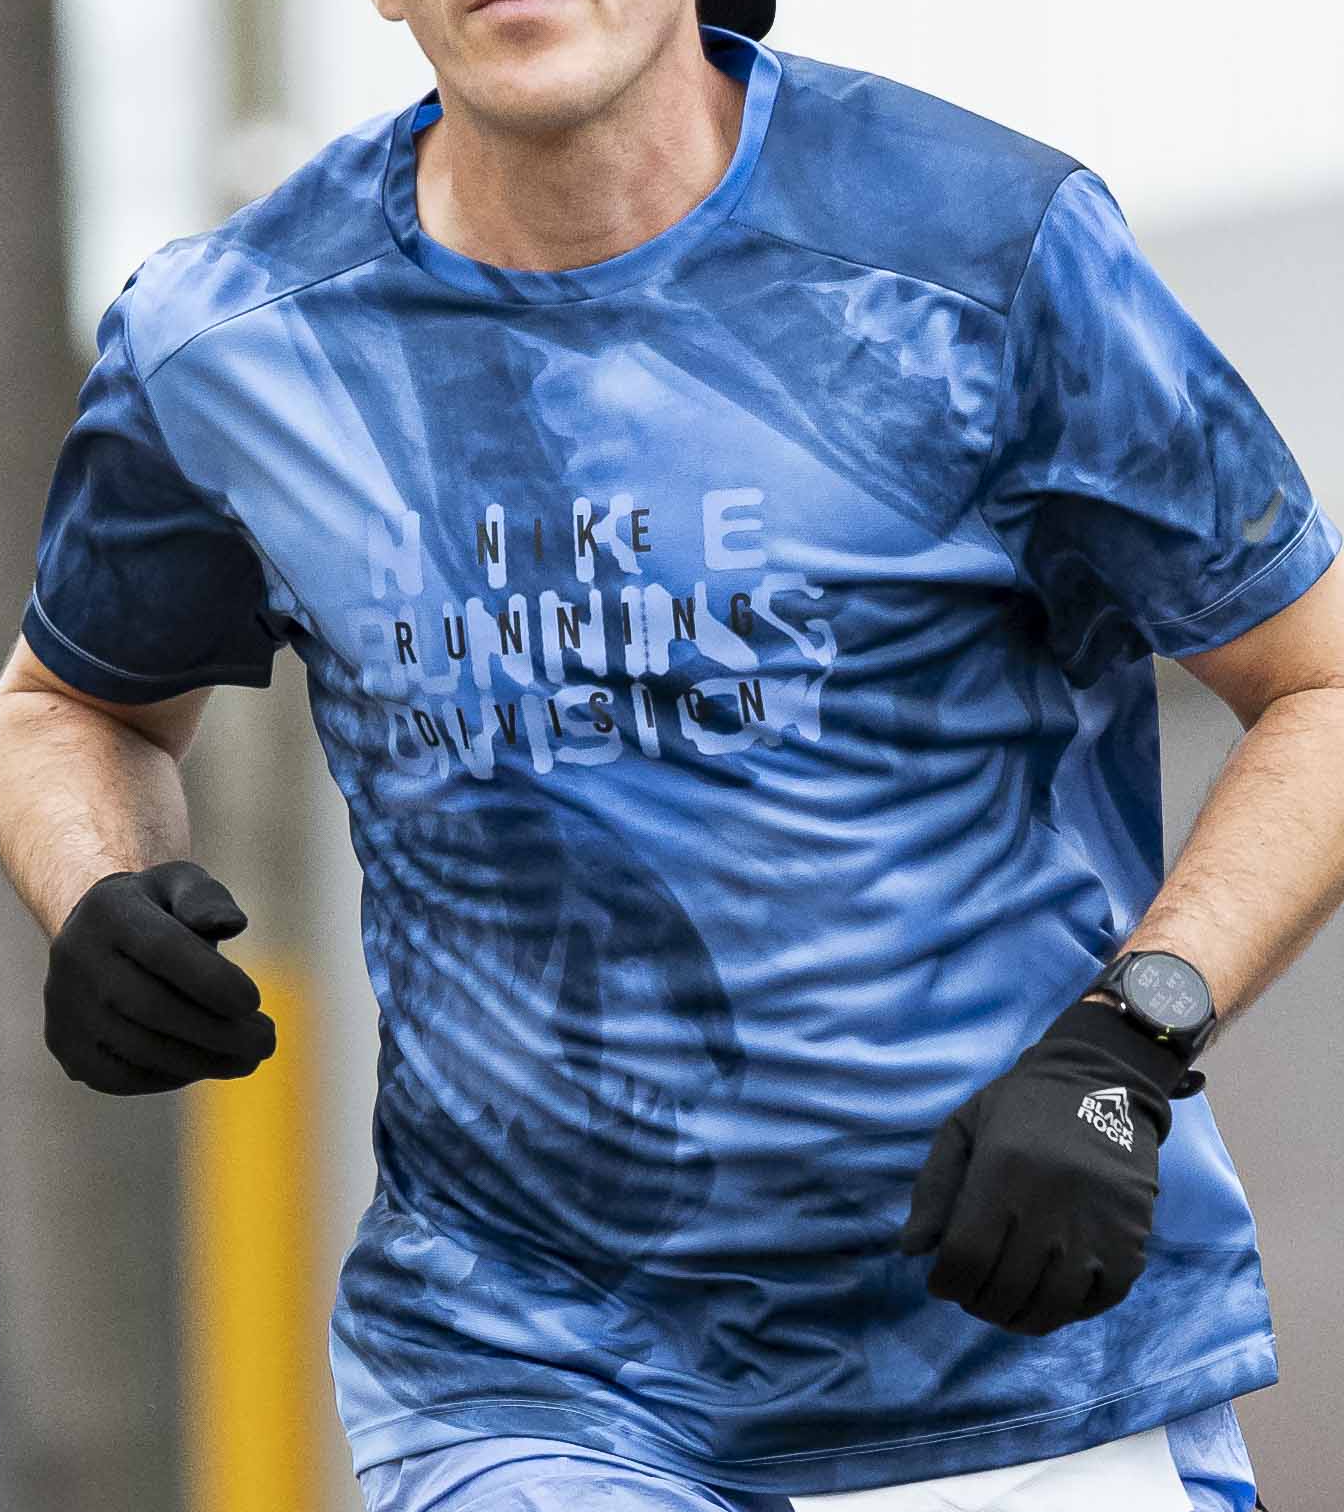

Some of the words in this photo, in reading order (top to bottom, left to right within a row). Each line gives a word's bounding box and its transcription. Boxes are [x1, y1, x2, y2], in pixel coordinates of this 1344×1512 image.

[477, 508, 652, 566] NIKE
[395, 592, 753, 664] RUNNING
[413, 679, 766, 748] DIVISION
[1077, 1106, 1133, 1152] ROCK
[1082, 1096, 1134, 1142] BLACK
